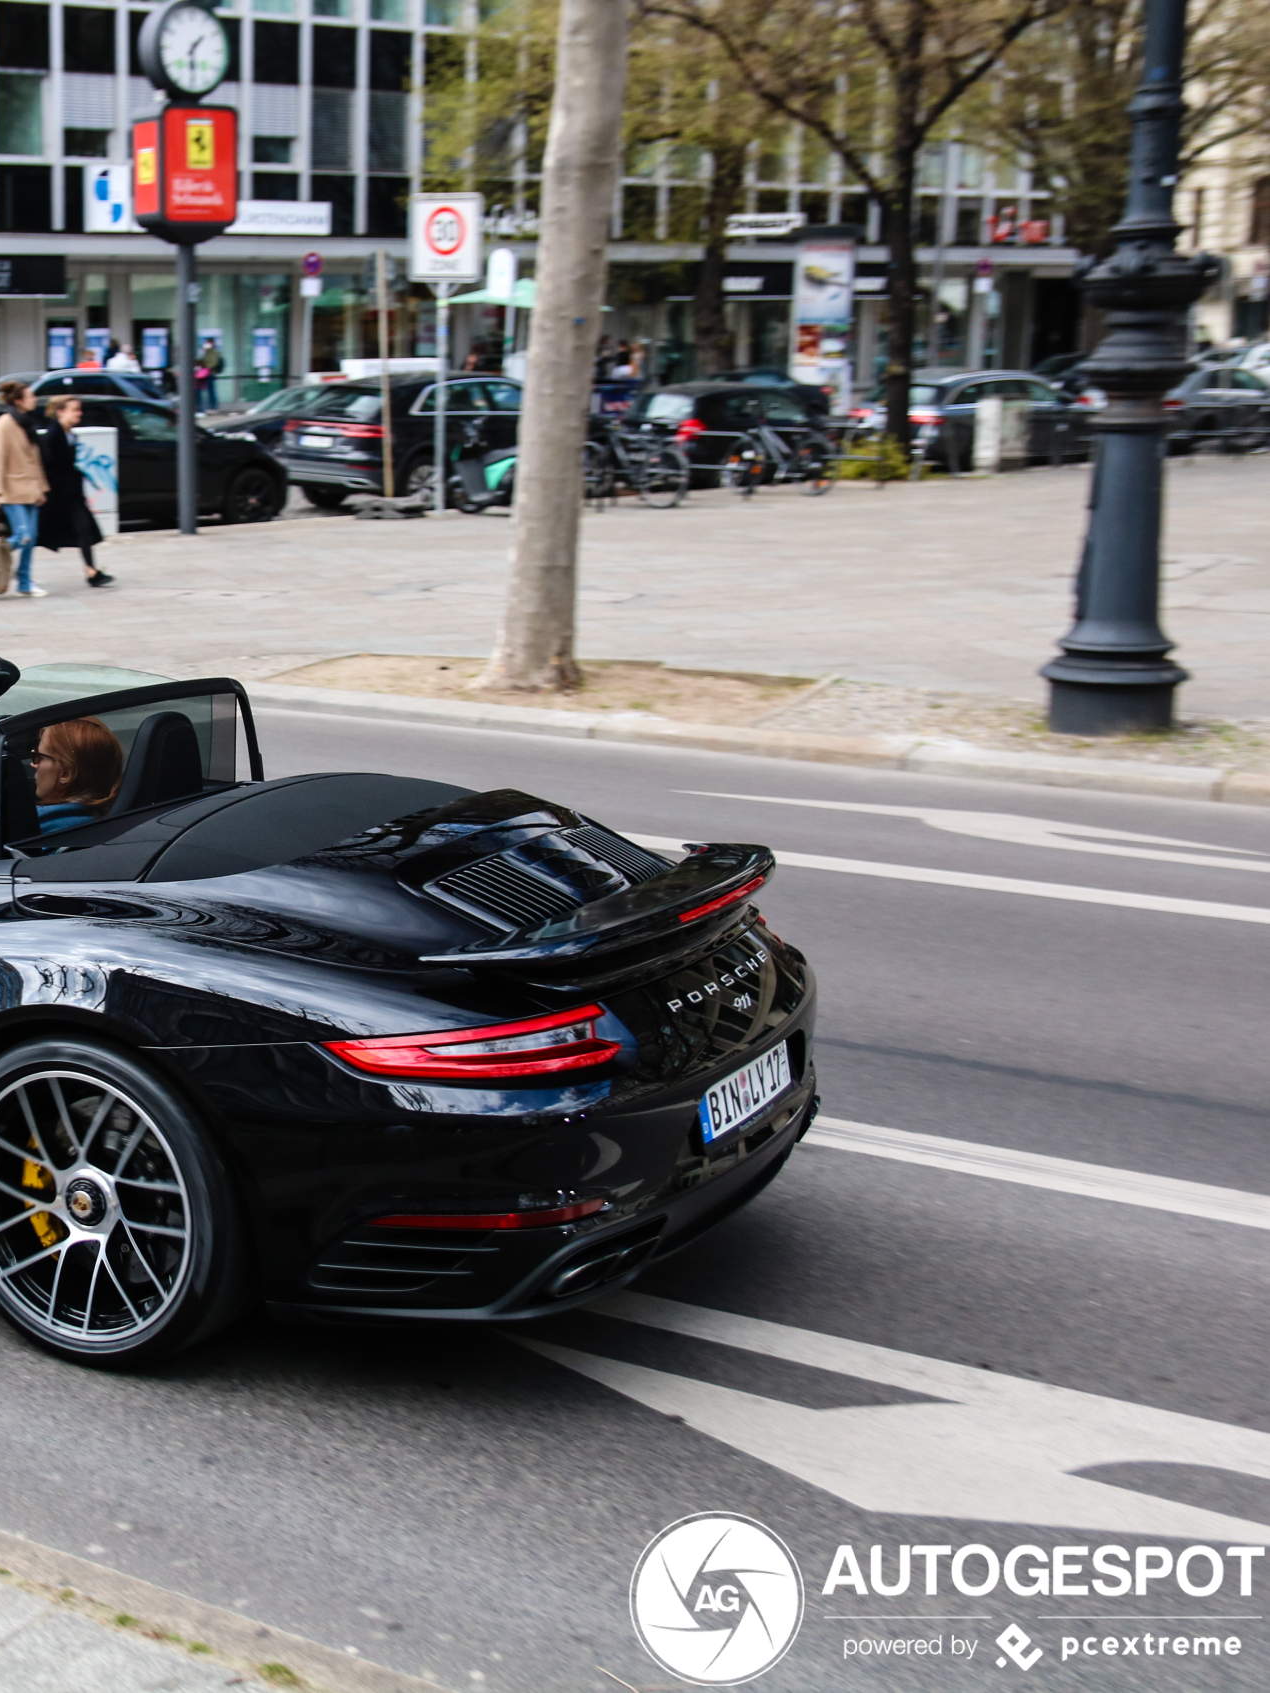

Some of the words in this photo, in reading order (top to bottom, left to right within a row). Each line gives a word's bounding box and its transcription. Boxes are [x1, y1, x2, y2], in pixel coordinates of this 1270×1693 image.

[432, 219, 457, 242] 30
[666, 950, 769, 1013] PORSCHE
[733, 992, 752, 1012] 911
[708, 1077, 743, 1132] BIN
[747, 1059, 766, 1106] LY
[766, 1048, 781, 1093] 17
[702, 1122, 709, 1134] D
